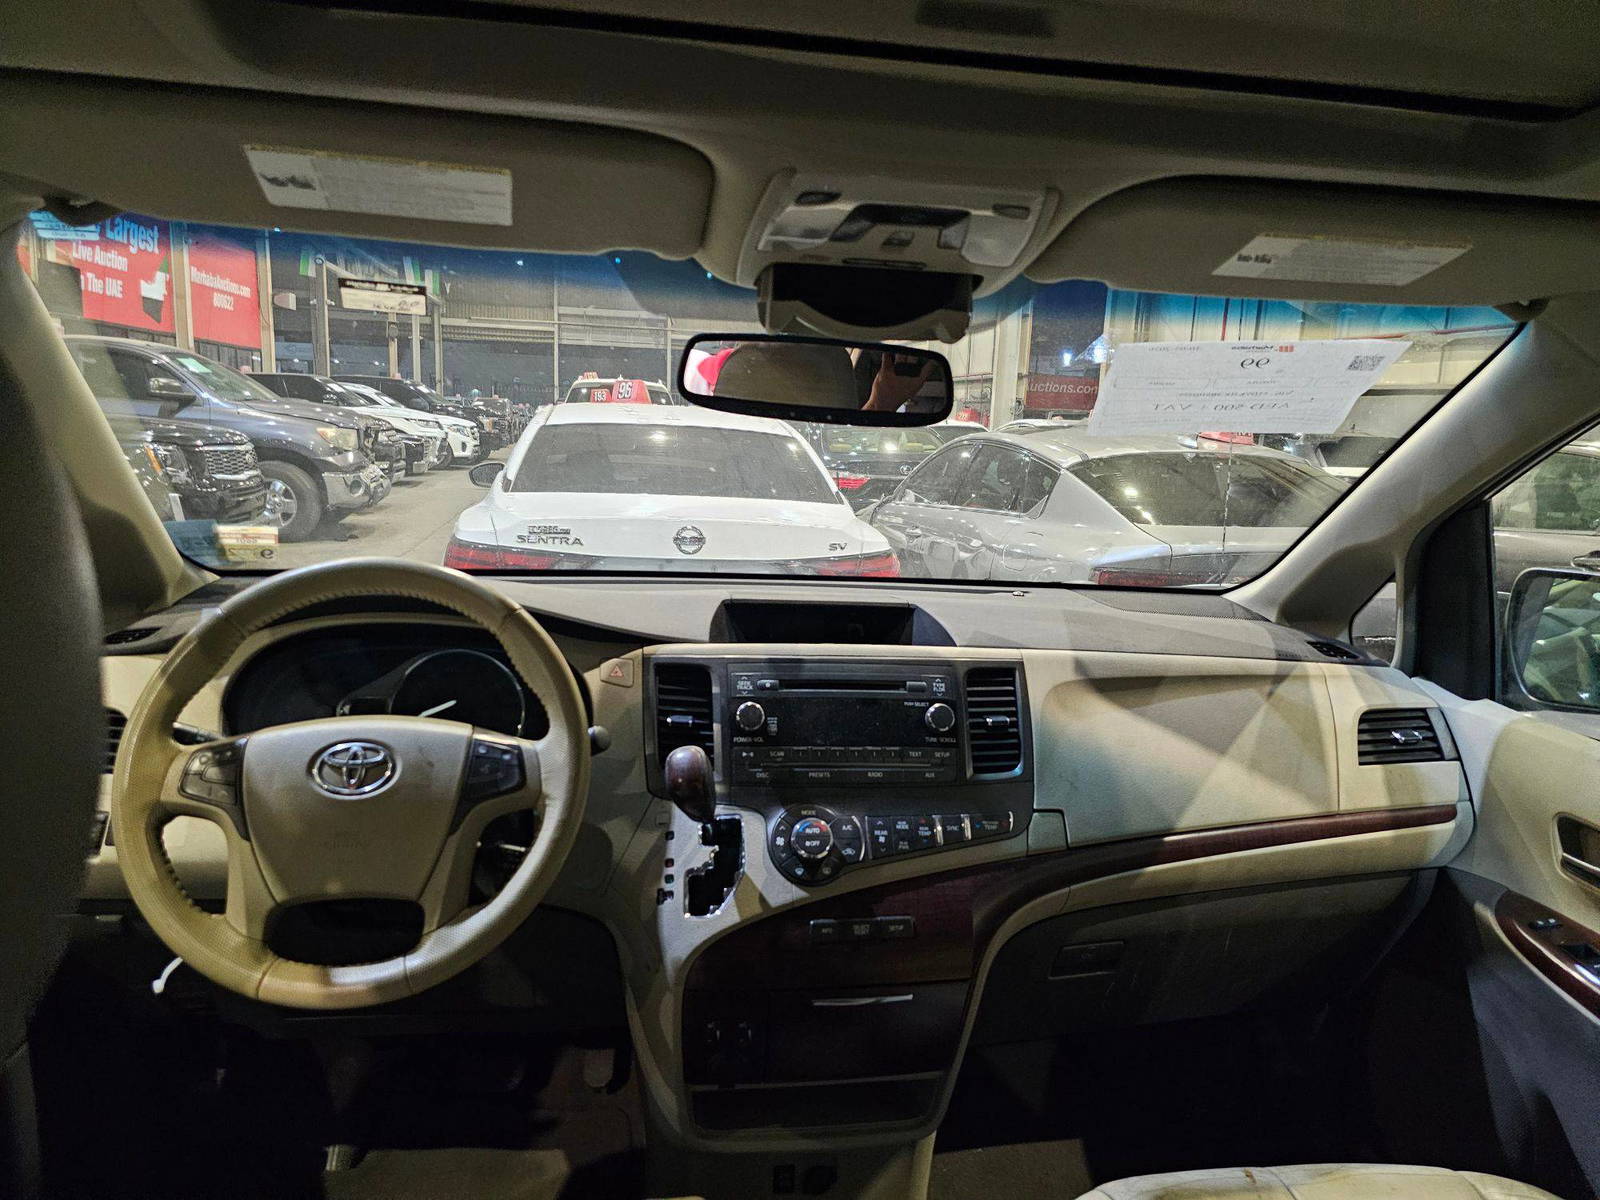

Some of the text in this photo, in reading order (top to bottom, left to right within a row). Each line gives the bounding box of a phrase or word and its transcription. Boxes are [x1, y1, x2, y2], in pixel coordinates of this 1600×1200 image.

[106, 217, 160, 254] Largest
[72, 241, 128, 272] Live Auction
[86, 272, 104, 295] The
[105, 277, 124, 298] UAE
[618, 381, 633, 399] 96
[516, 534, 584, 546] SENTRA
[829, 543, 847, 551] SV
